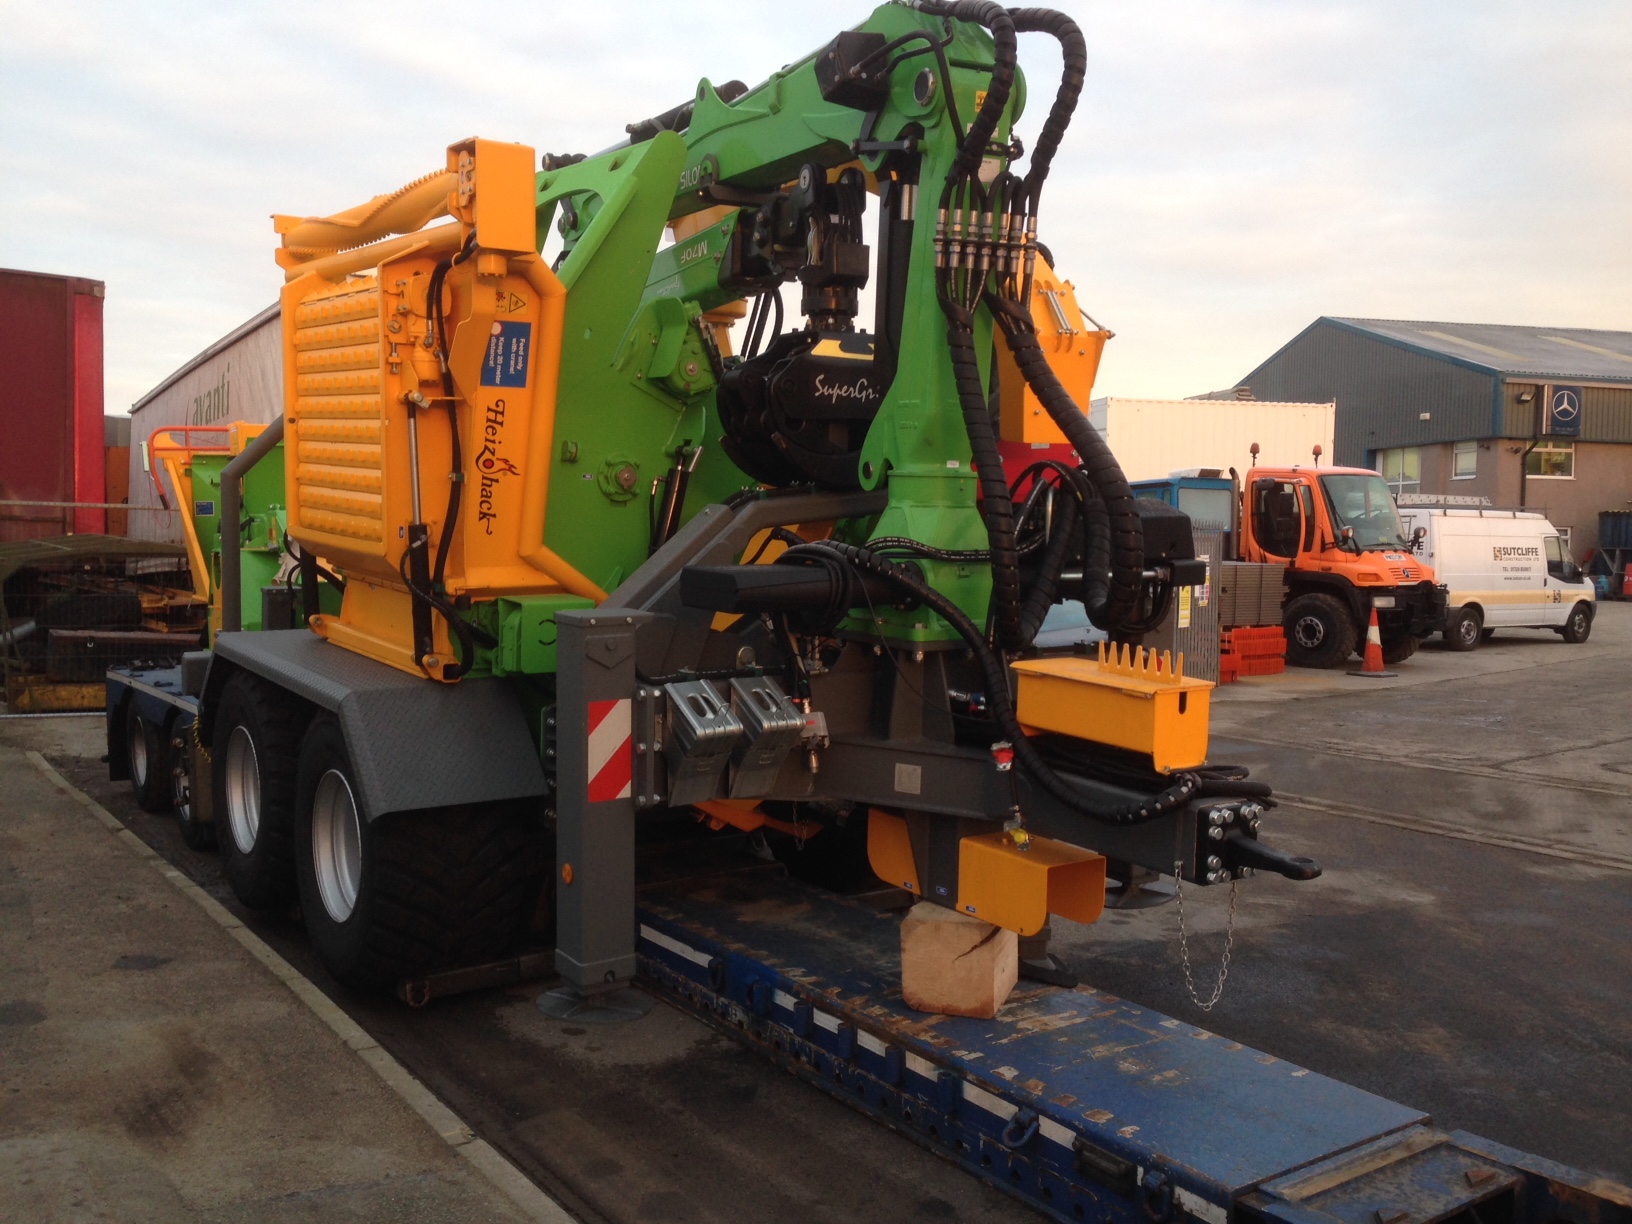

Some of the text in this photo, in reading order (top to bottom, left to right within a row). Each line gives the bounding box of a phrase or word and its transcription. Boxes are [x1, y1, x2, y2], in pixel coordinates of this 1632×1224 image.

[680, 240, 708, 264] M70F
[497, 337, 505, 355] Keep
[518, 338, 526, 355] Feed
[497, 355, 503, 364] 20
[509, 353, 517, 374] crane!
[192, 362, 230, 426] avanti
[1502, 547, 1539, 556] SUTCLIFFE
